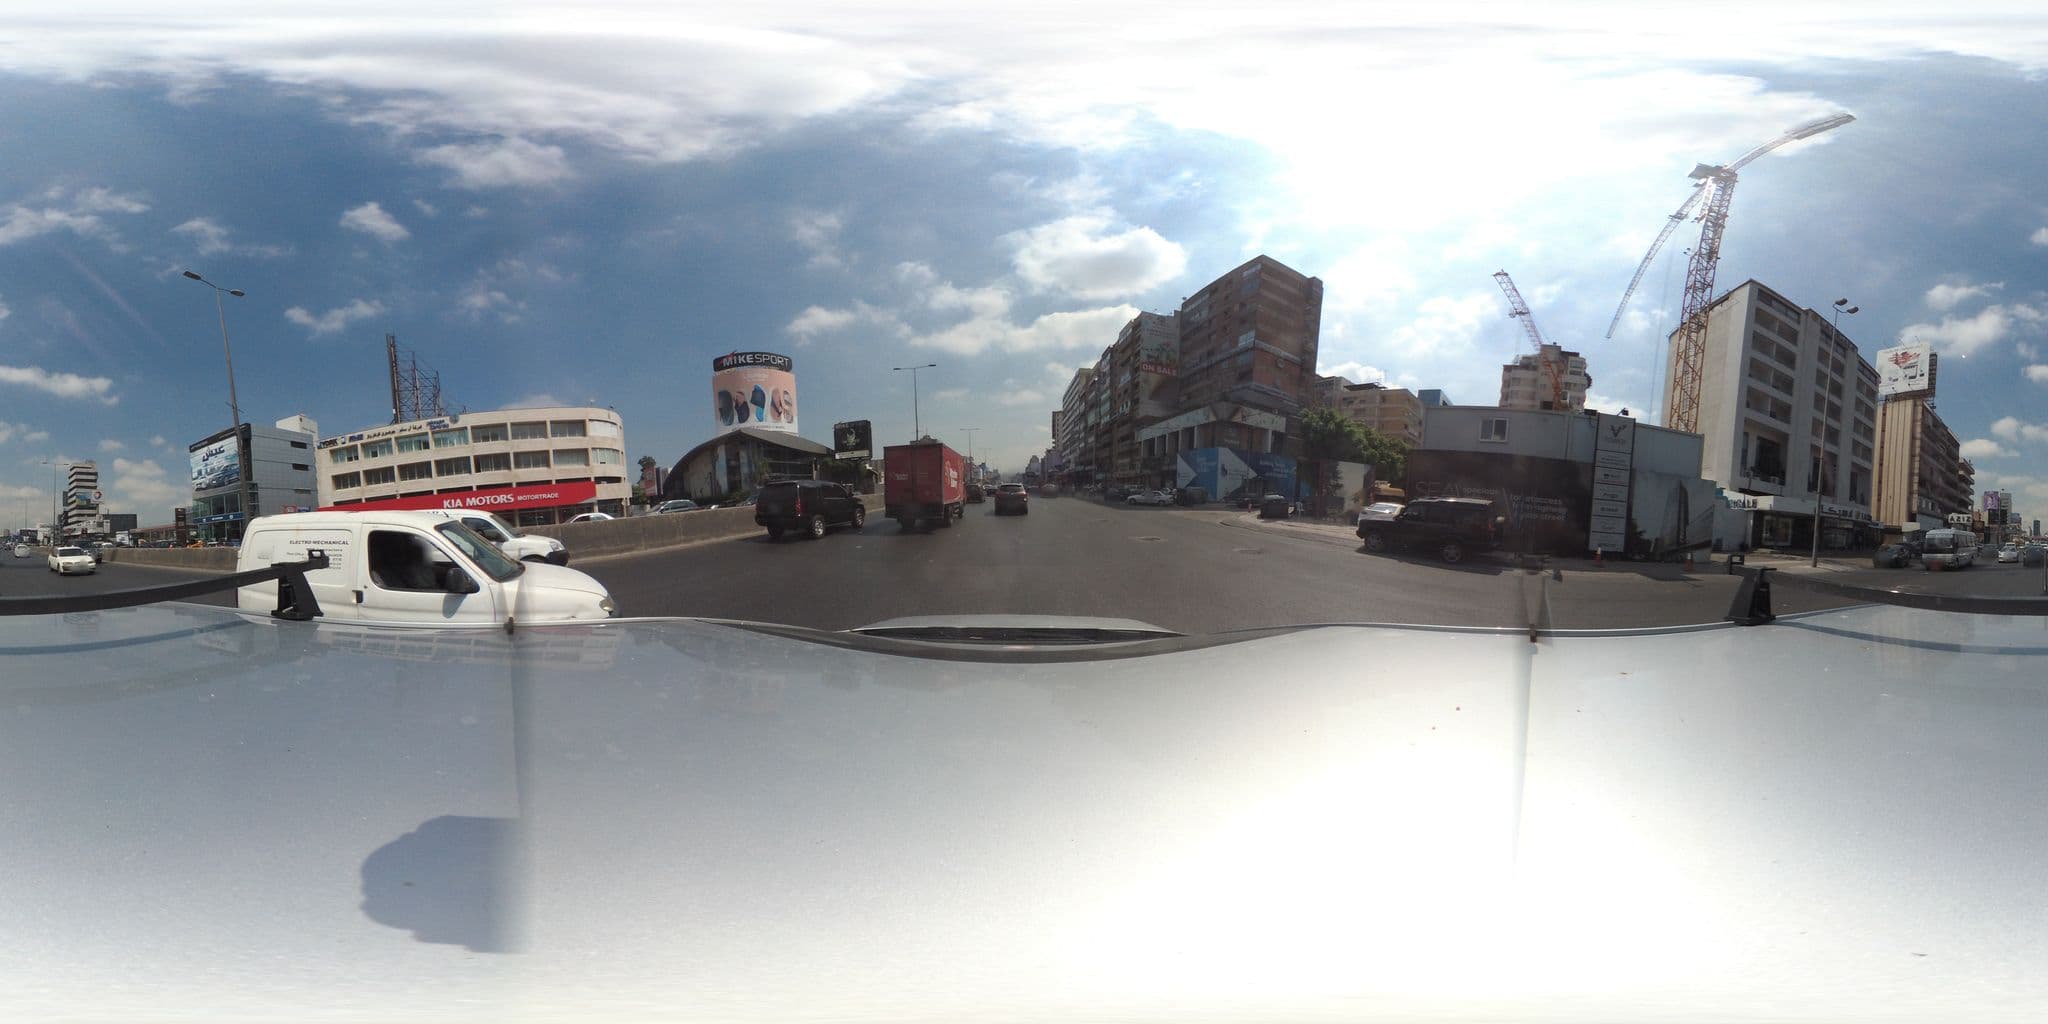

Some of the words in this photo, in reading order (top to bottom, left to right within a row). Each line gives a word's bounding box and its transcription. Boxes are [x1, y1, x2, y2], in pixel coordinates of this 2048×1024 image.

[443, 499, 464, 509] KIA
[466, 493, 515, 506] MOTORS
[517, 492, 559, 501] MOTORTRADE
